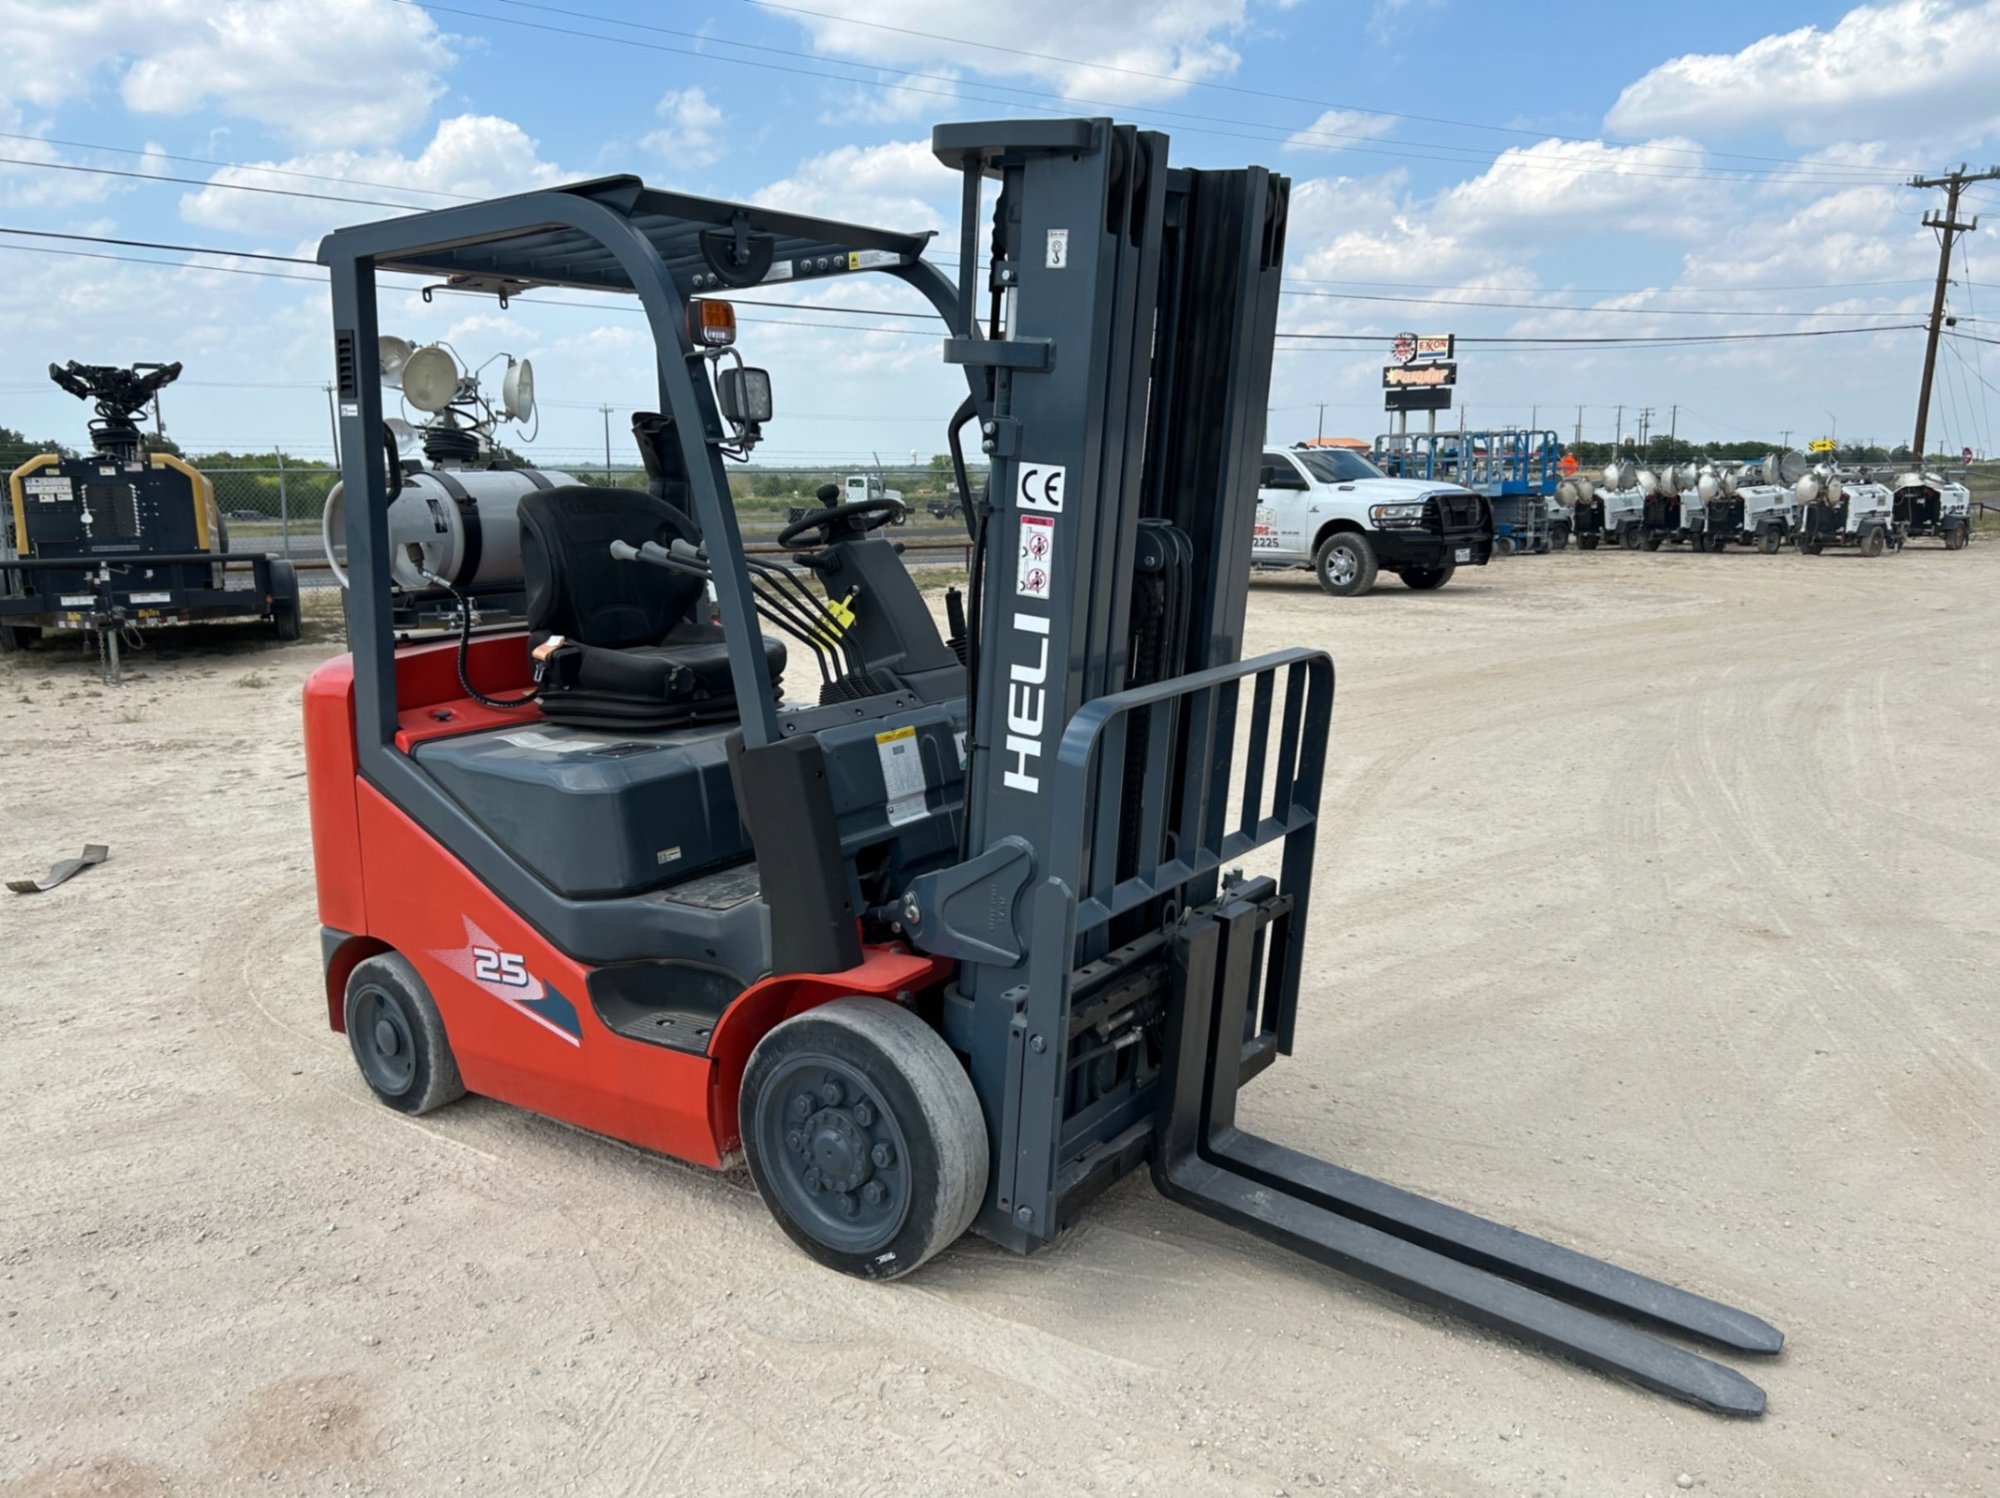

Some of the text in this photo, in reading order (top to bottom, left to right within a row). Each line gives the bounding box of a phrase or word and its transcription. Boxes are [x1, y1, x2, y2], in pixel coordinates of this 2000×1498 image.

[1419, 339, 1447, 351] EXXON
[1021, 469, 1061, 506] CE
[1003, 612, 1050, 794] HELI
[472, 946, 529, 988] 25
